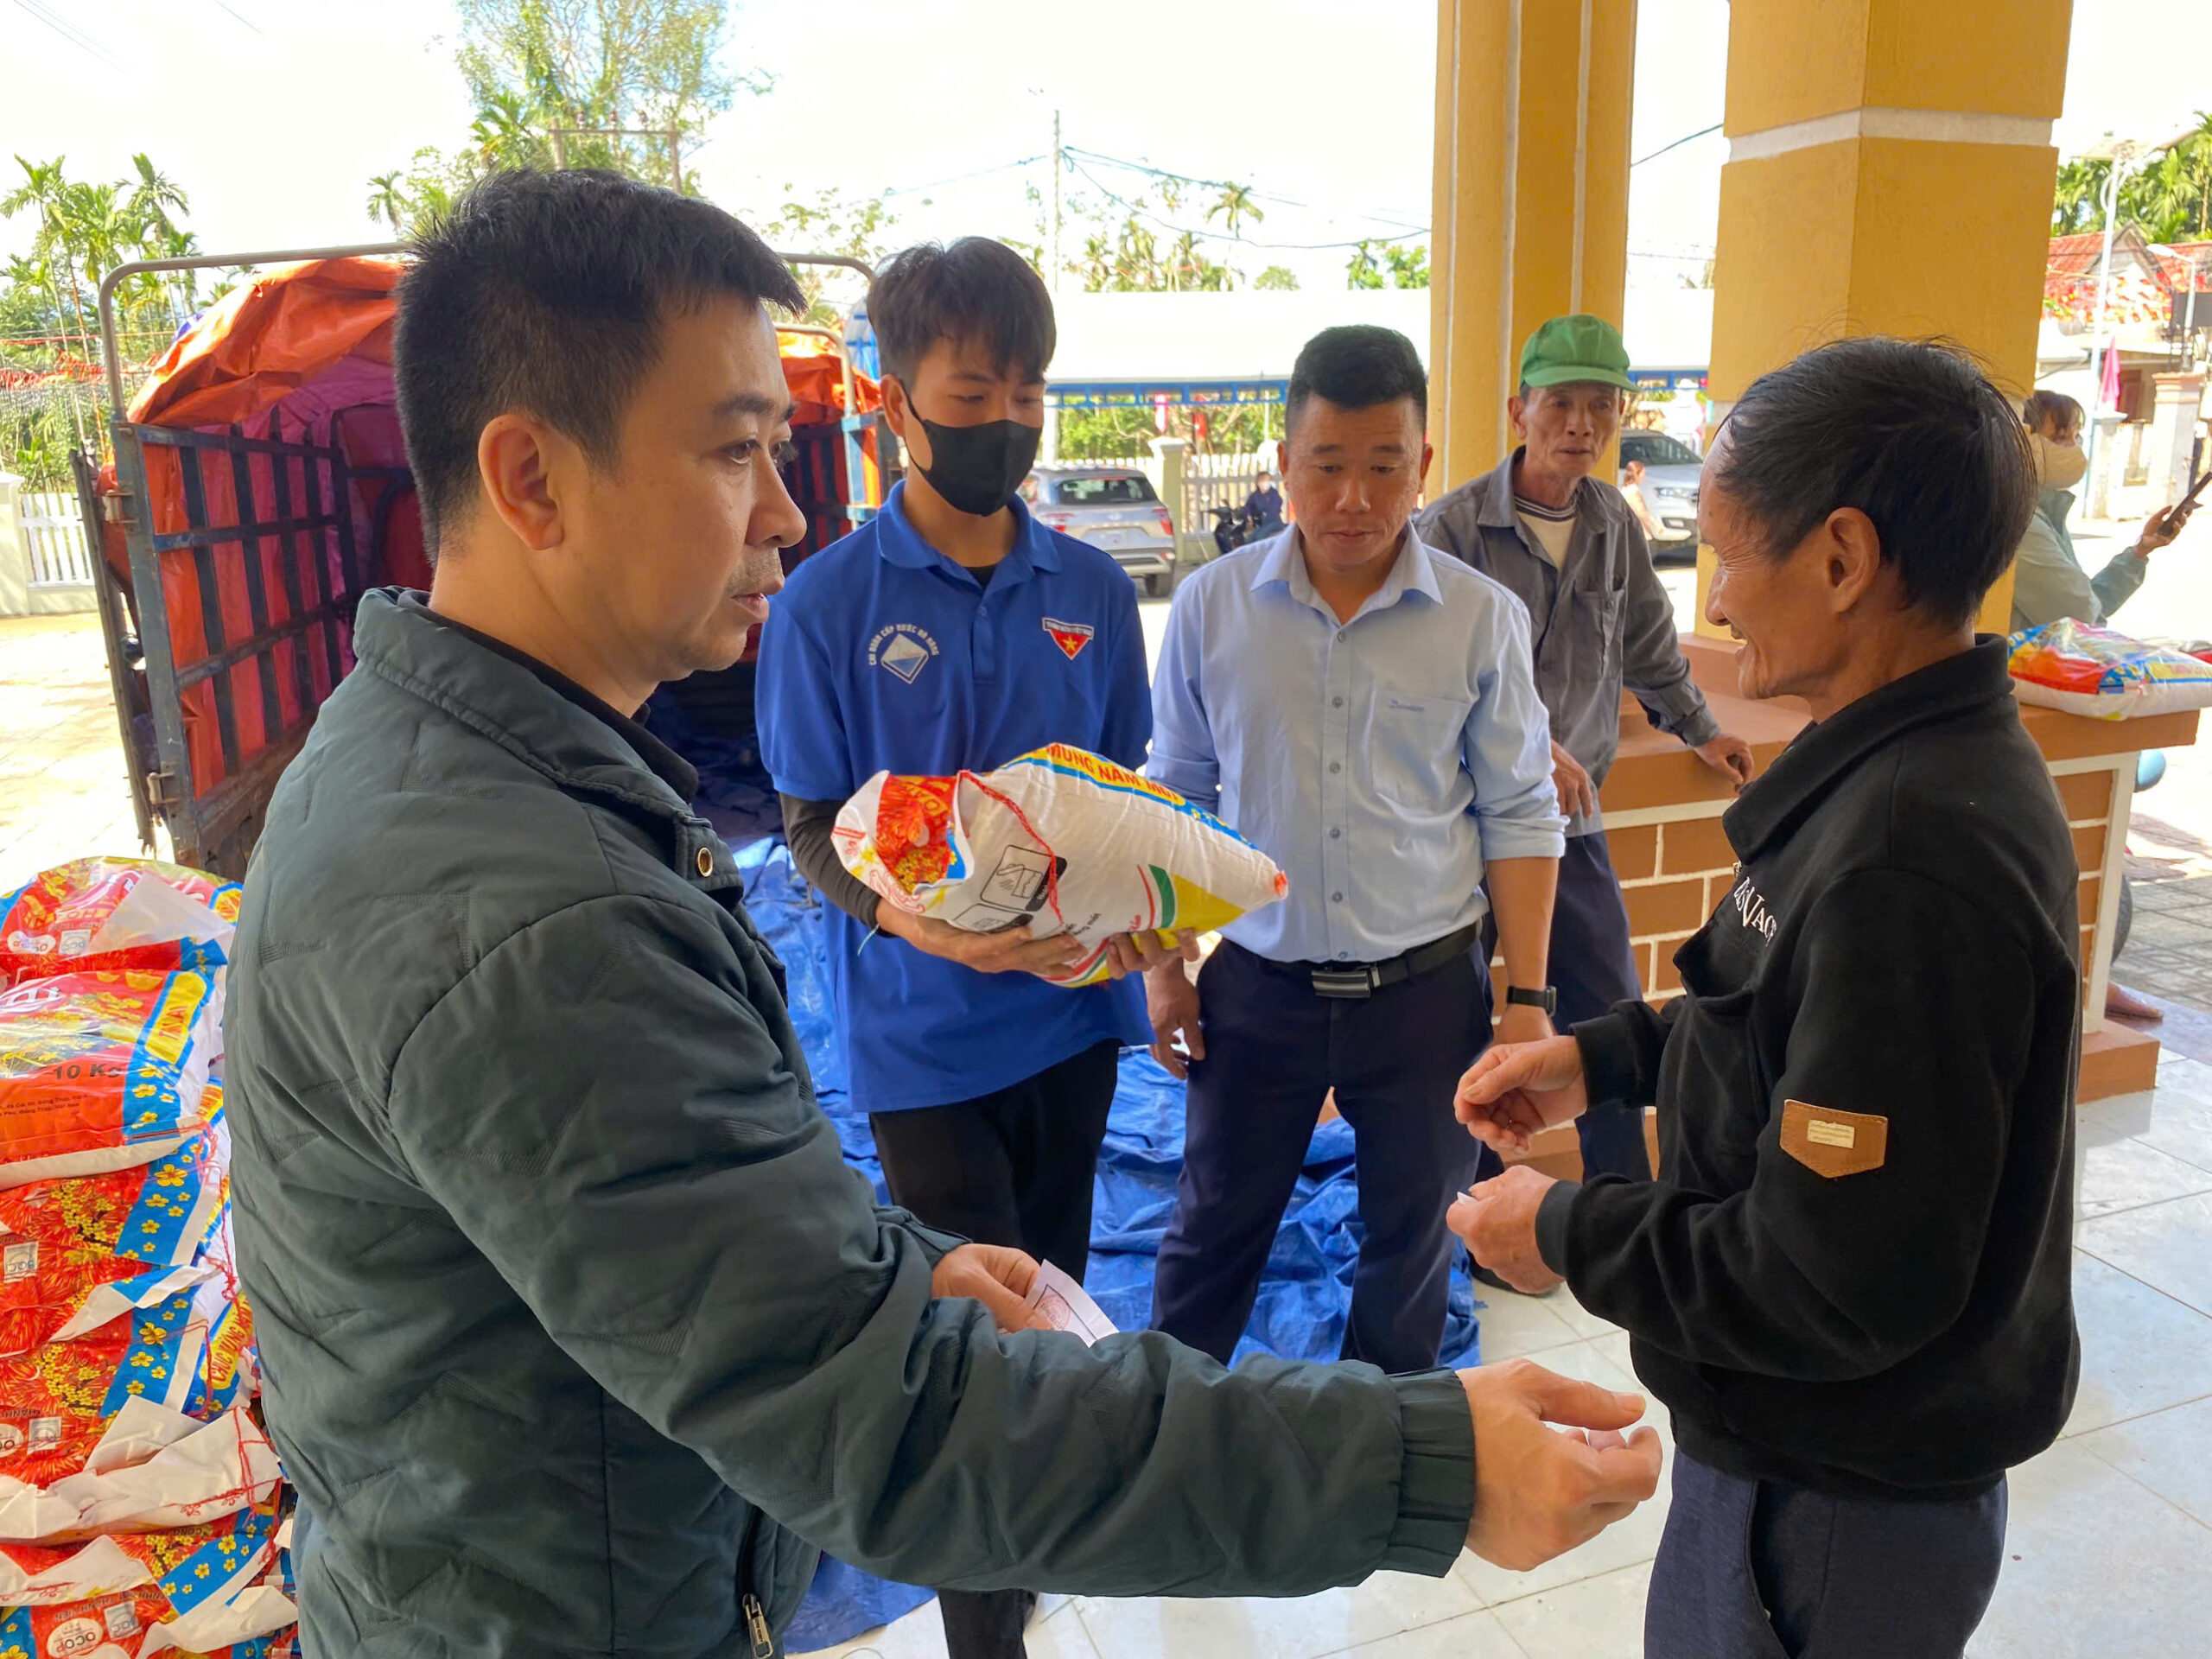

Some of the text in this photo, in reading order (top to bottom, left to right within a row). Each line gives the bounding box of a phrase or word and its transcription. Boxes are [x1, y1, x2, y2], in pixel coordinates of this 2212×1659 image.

[54, 1063, 123, 1080] 10 Kg
[55, 1630, 97, 1654] OCOP
